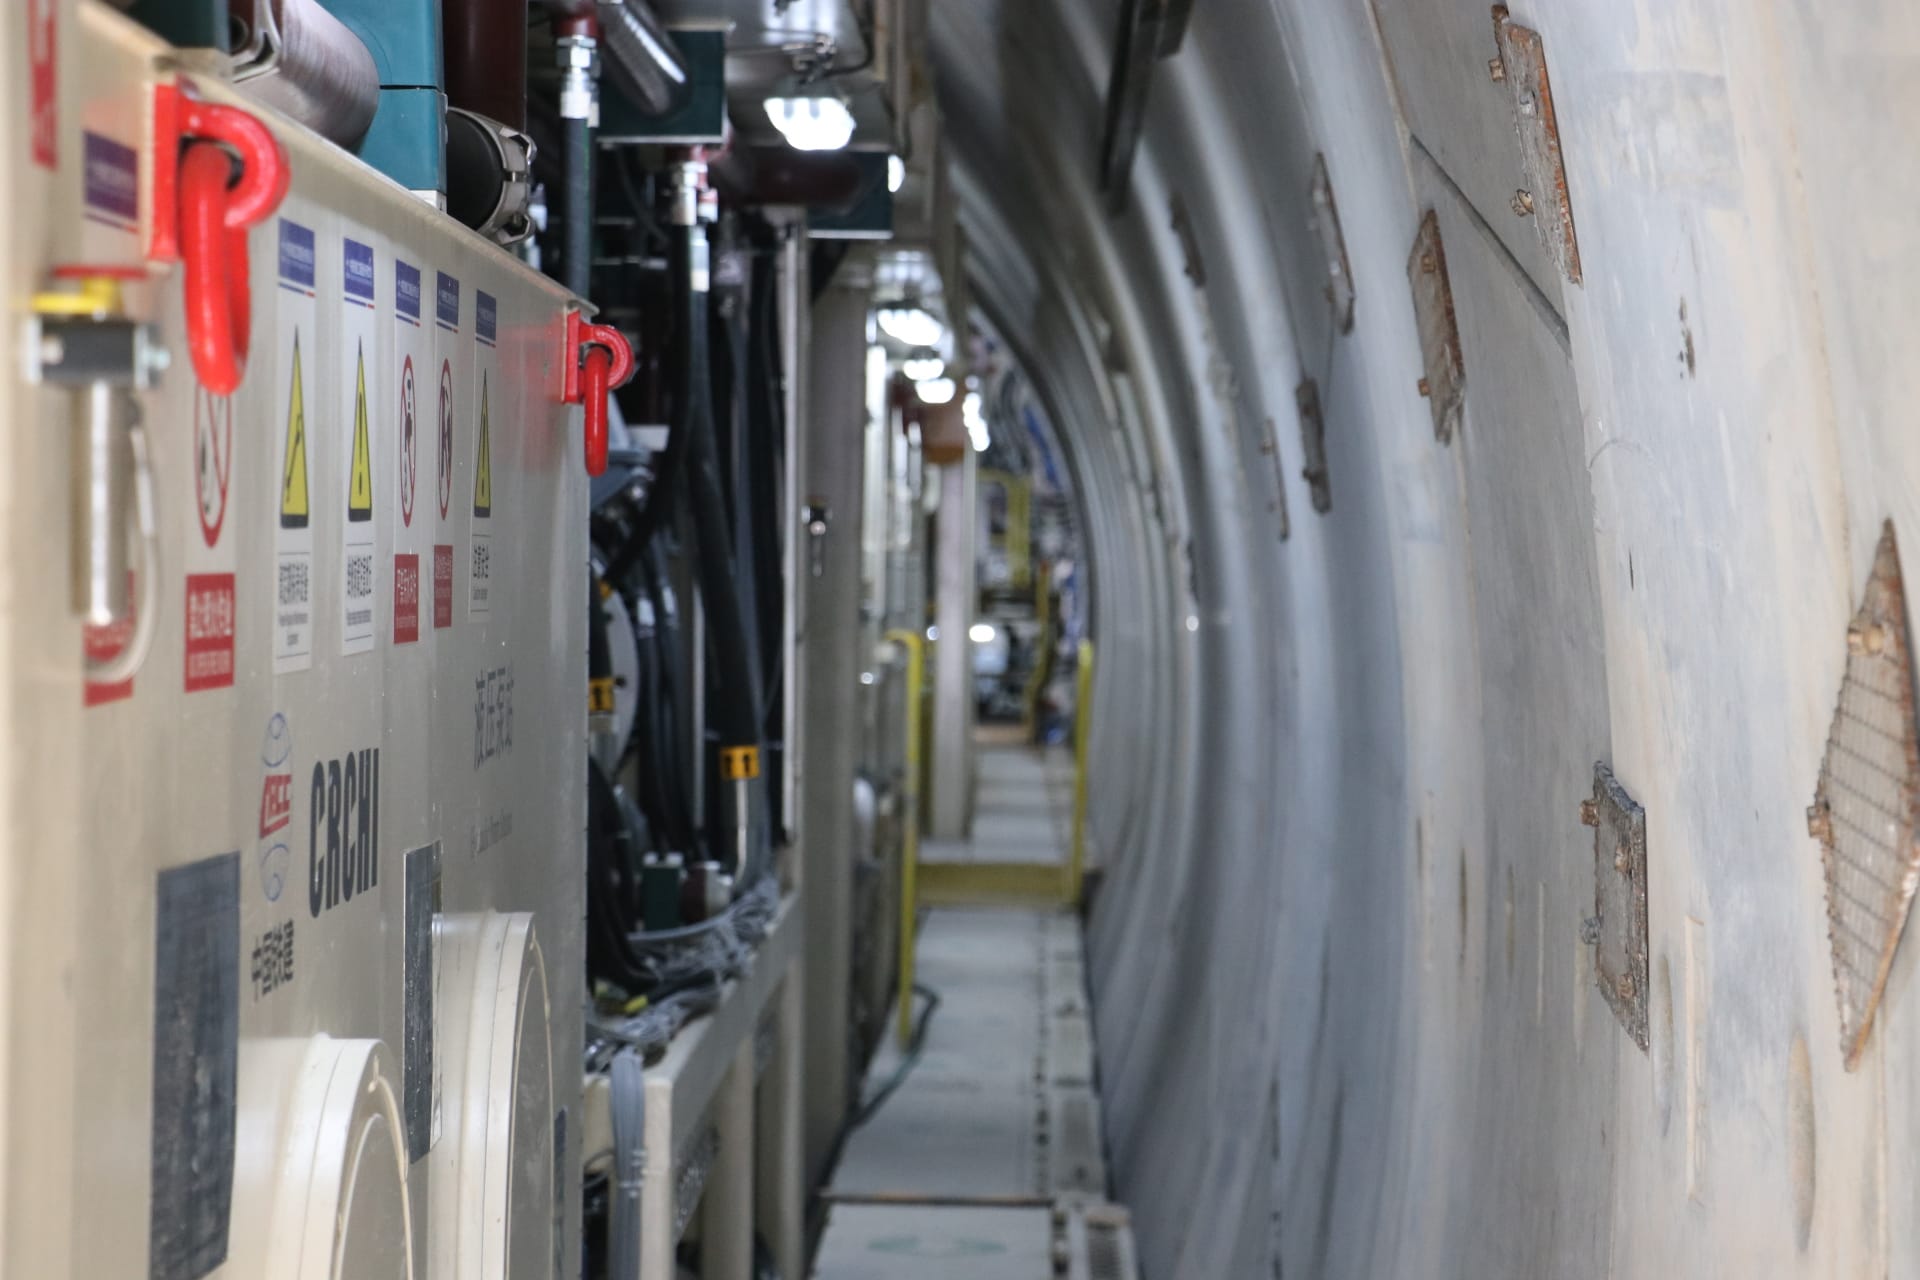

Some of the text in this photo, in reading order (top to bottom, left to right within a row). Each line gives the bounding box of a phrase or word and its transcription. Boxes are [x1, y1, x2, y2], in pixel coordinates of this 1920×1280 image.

[309, 748, 380, 918] CRCHI
[251, 919, 295, 1002] 中国铁建
